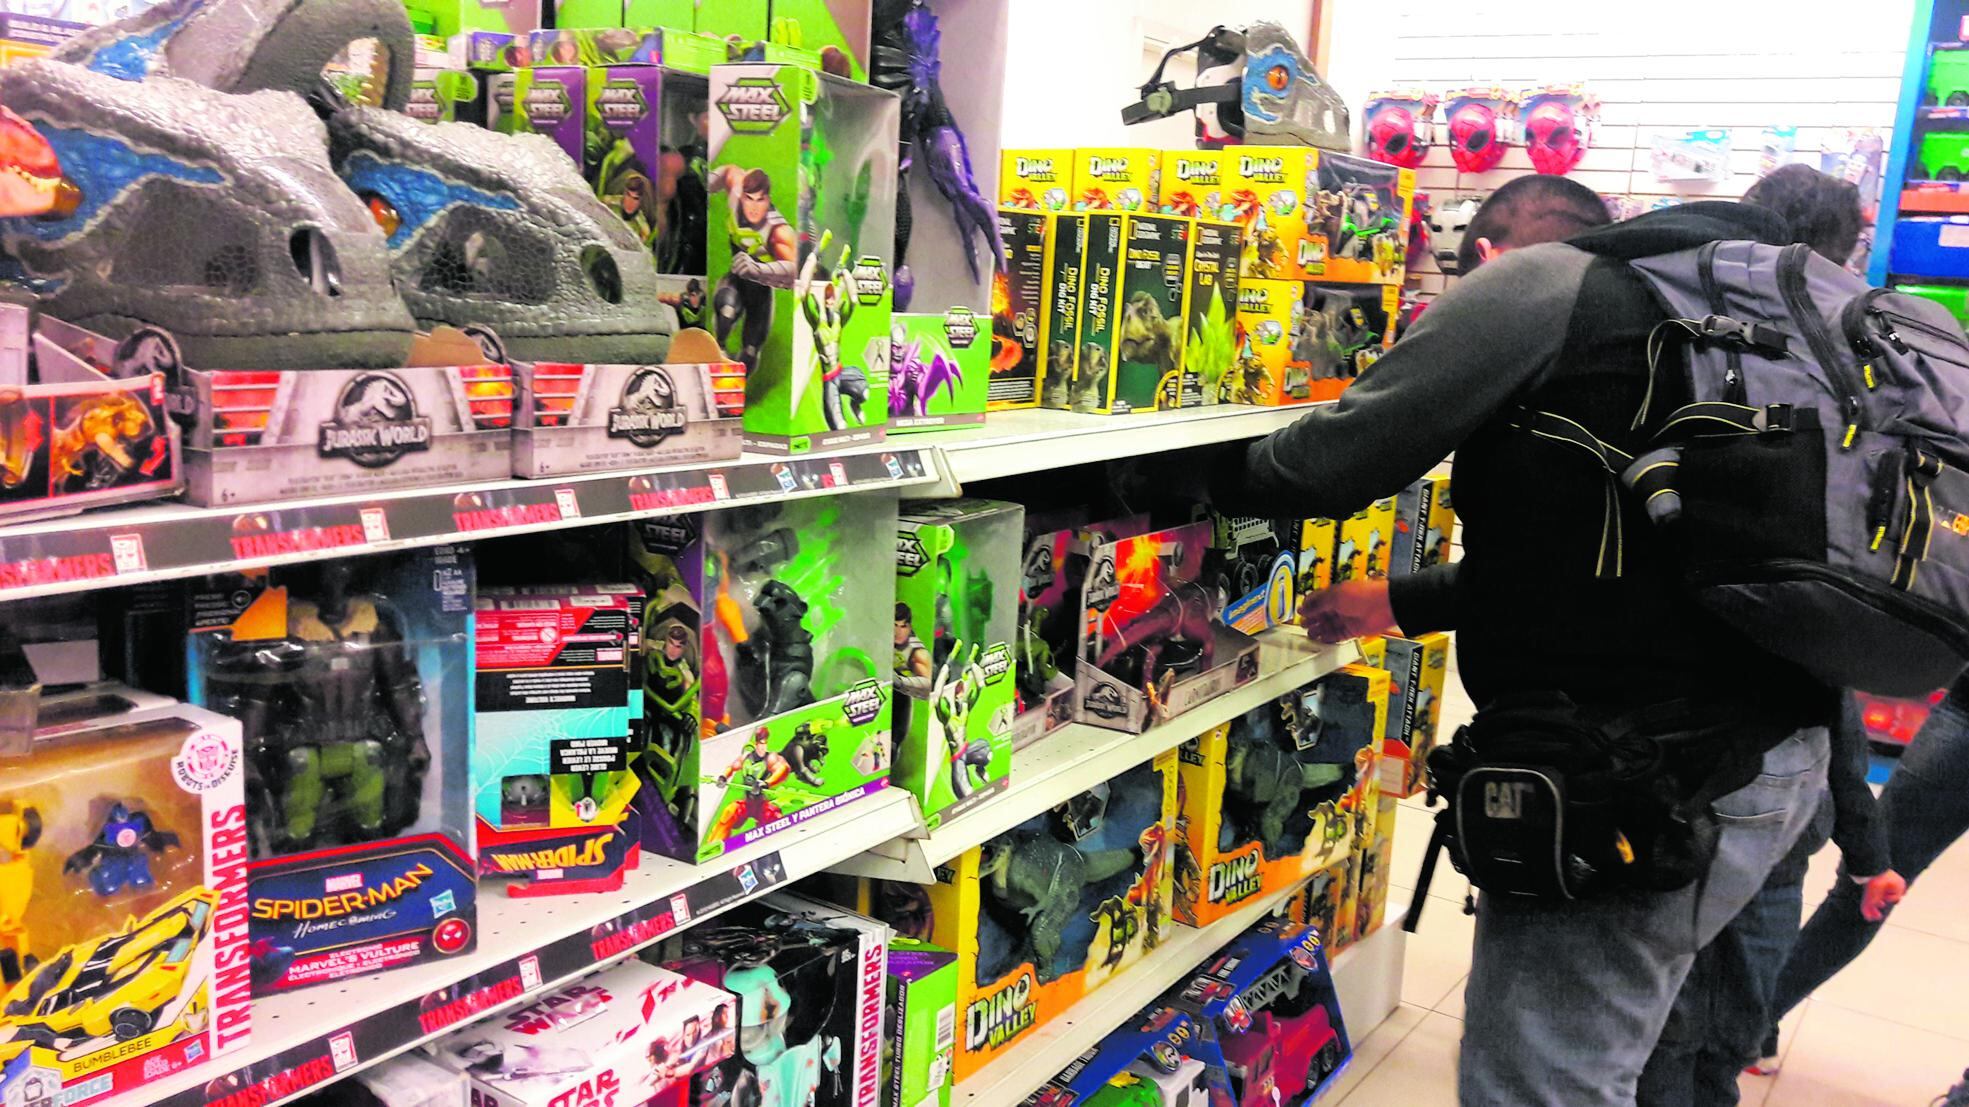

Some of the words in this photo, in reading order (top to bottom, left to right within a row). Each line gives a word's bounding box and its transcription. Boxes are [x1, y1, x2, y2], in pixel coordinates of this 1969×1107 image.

[527, 86, 569, 103] MAX
[602, 86, 643, 103] MAX
[727, 85, 775, 104] MAX
[526, 102, 567, 116] STEEL
[601, 102, 641, 116] STEEL
[727, 104, 782, 121] STEEL
[1017, 157, 1053, 177] DINO
[1090, 156, 1129, 177] DINO
[1176, 159, 1218, 180] DINO
[1239, 156, 1283, 178] DINO
[1067, 267, 1079, 294] DINO
[1098, 267, 1111, 294] DINO
[648, 410, 686, 431] WORLD
[323, 428, 379, 452] JURASSIC
[380, 424, 428, 449] WORLD
[846, 686, 878, 705] MAX
[848, 699, 881, 718] STEEL
[176, 760, 204, 791] ROBOTS
[1484, 781, 1536, 820] CAT
[744, 827, 765, 843] MAX
[765, 817, 792, 835] STEEL
[792, 813, 800, 823] Y
[798, 799, 835, 821] PANTERA
[491, 832, 615, 872] SPIDER-MAN
[1208, 848, 1260, 902] DINO
[251, 862, 434, 921] SPIDER-MAN
[1225, 874, 1264, 905] VALLEY
[211, 803, 251, 1050] TRANSFORMERS
[288, 953, 359, 975] MARVEL'S
[360, 941, 421, 963] VULTURE
[418, 975, 524, 1035] TRANSFORMERS
[965, 972, 1031, 1052] DINO
[857, 943, 883, 1107] TRANSFORMERS
[988, 1000, 1038, 1050] VALLEY
[73, 1036, 152, 1073] BUMBLEBEE
[203, 1054, 335, 1107] TRANSFORMERS
